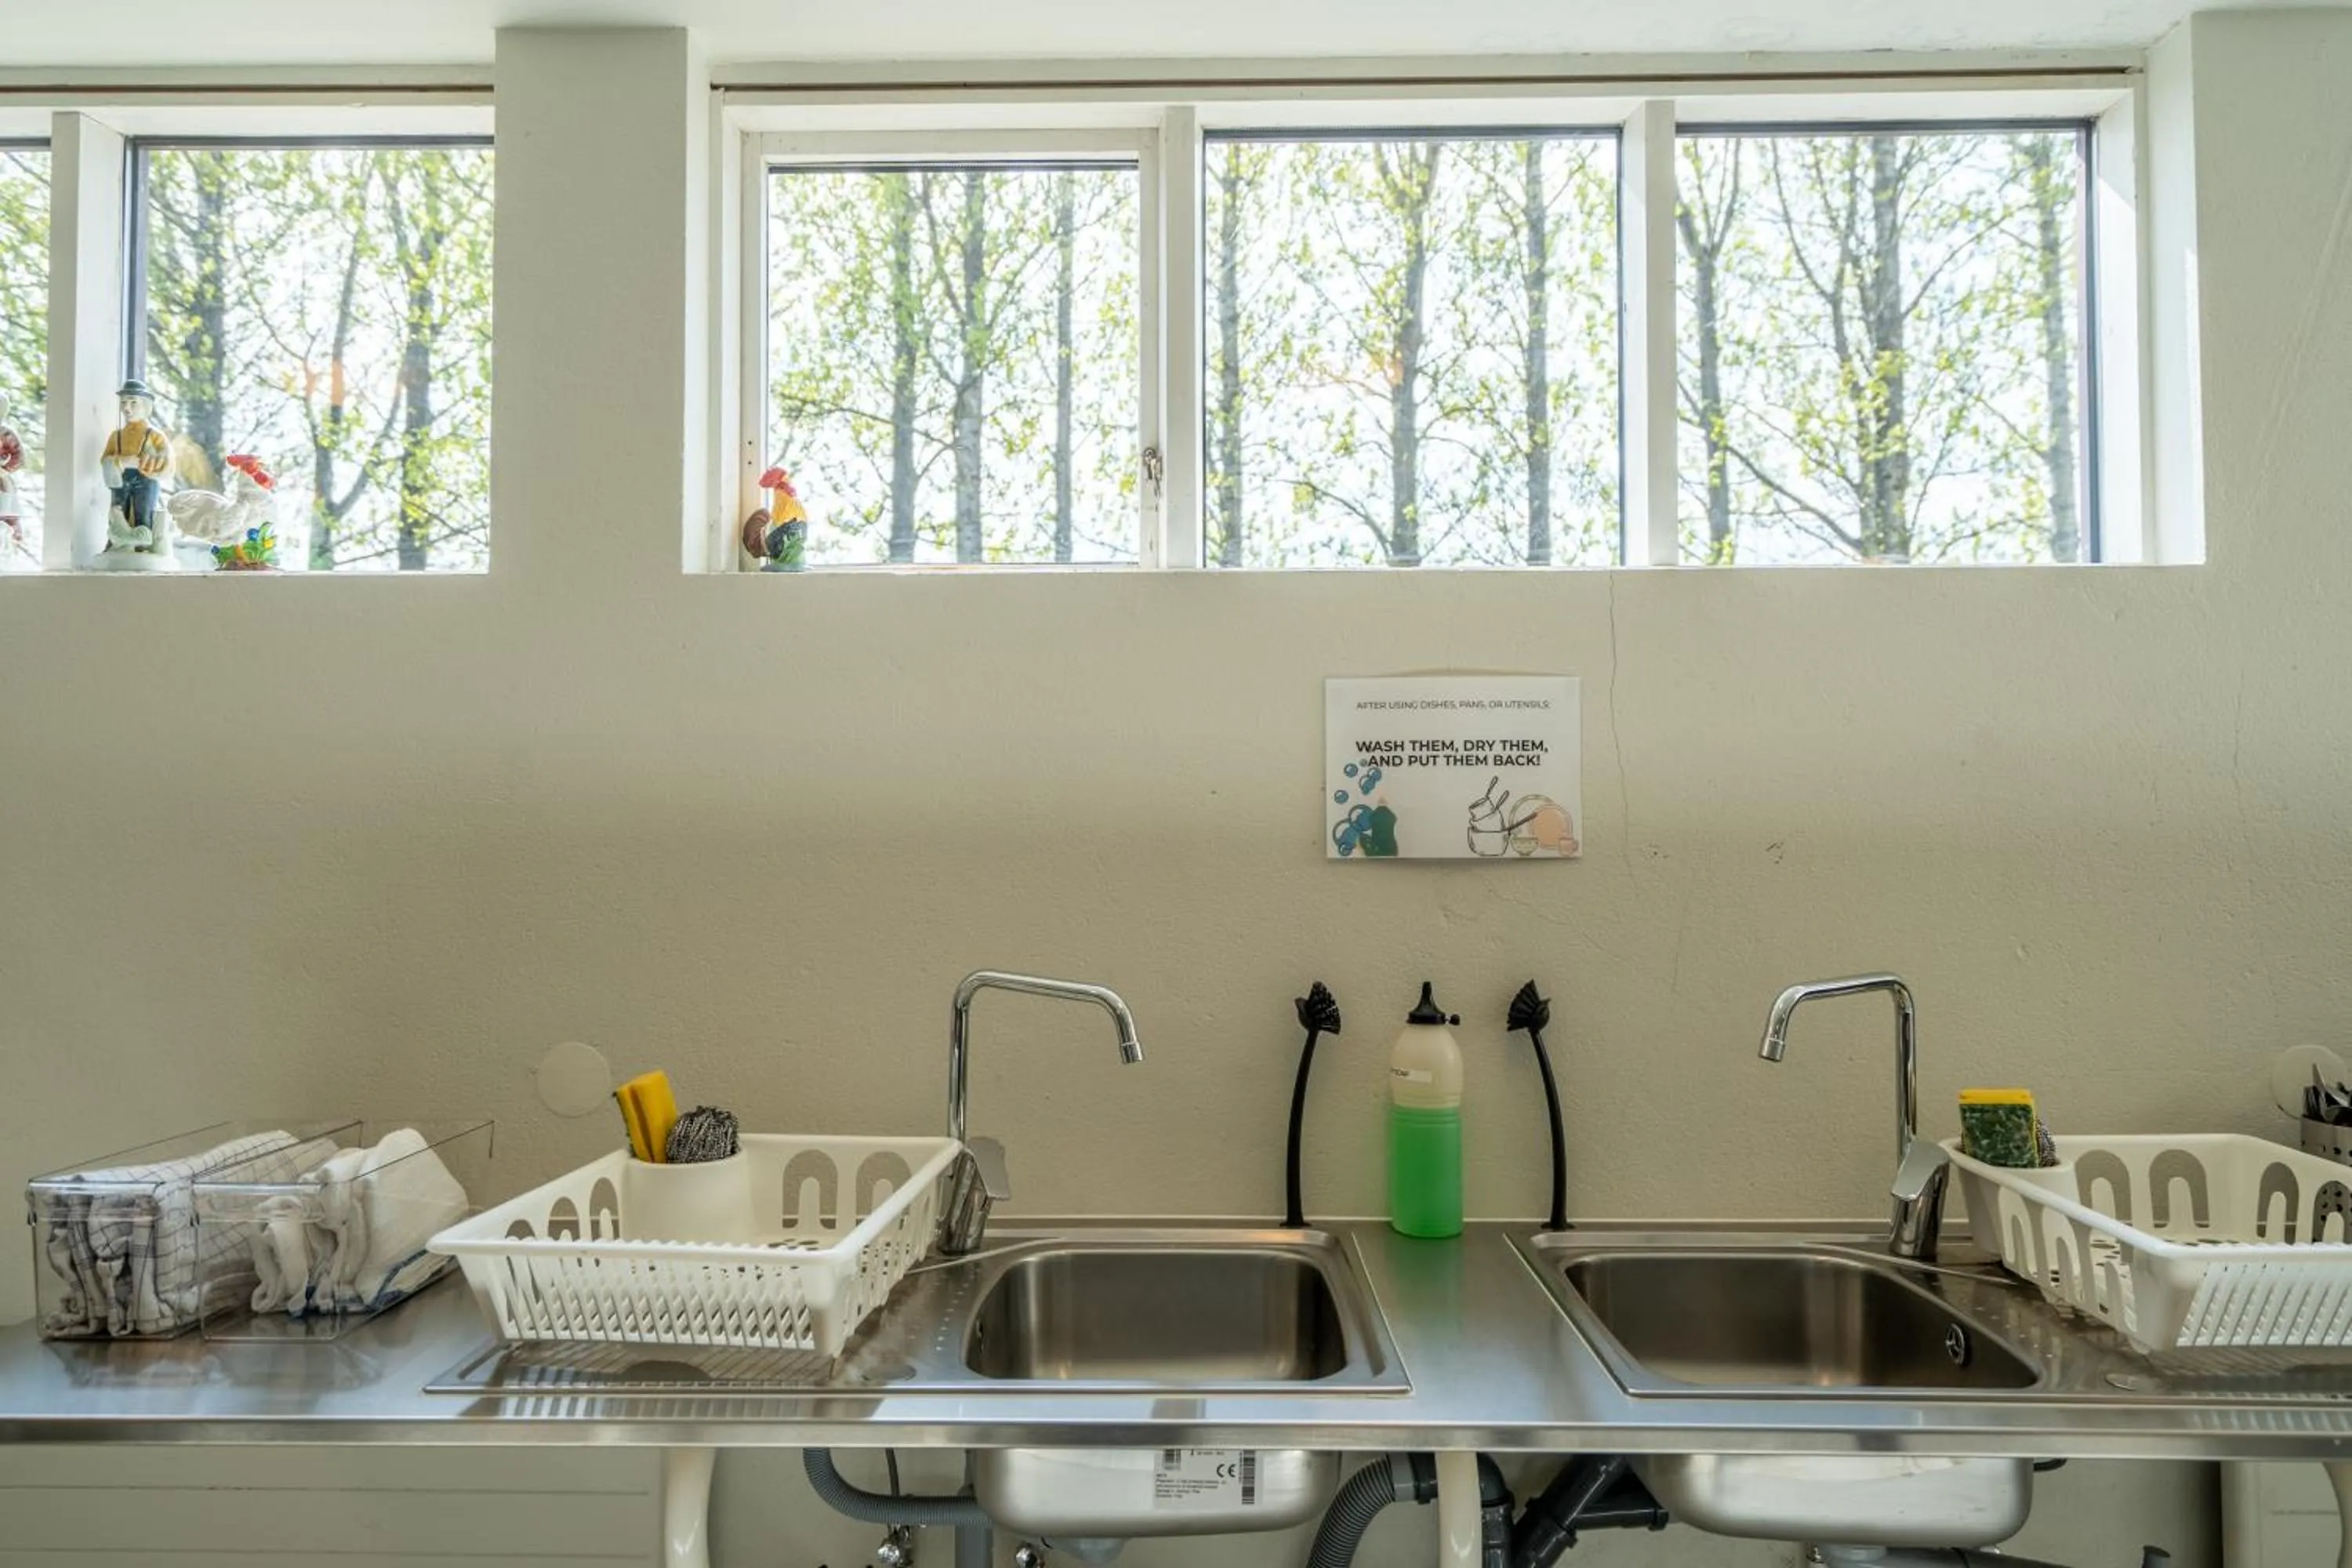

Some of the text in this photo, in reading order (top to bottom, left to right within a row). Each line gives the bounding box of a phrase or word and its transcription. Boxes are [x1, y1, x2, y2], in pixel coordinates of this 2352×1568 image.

[1490, 700, 1503, 709] OR
[1356, 739, 1548, 753] WASH THEM, DRY THEM,
[1367, 754, 1541, 767] AND PUT THEM BACK!
[1216, 1463, 1236, 1478] CE
